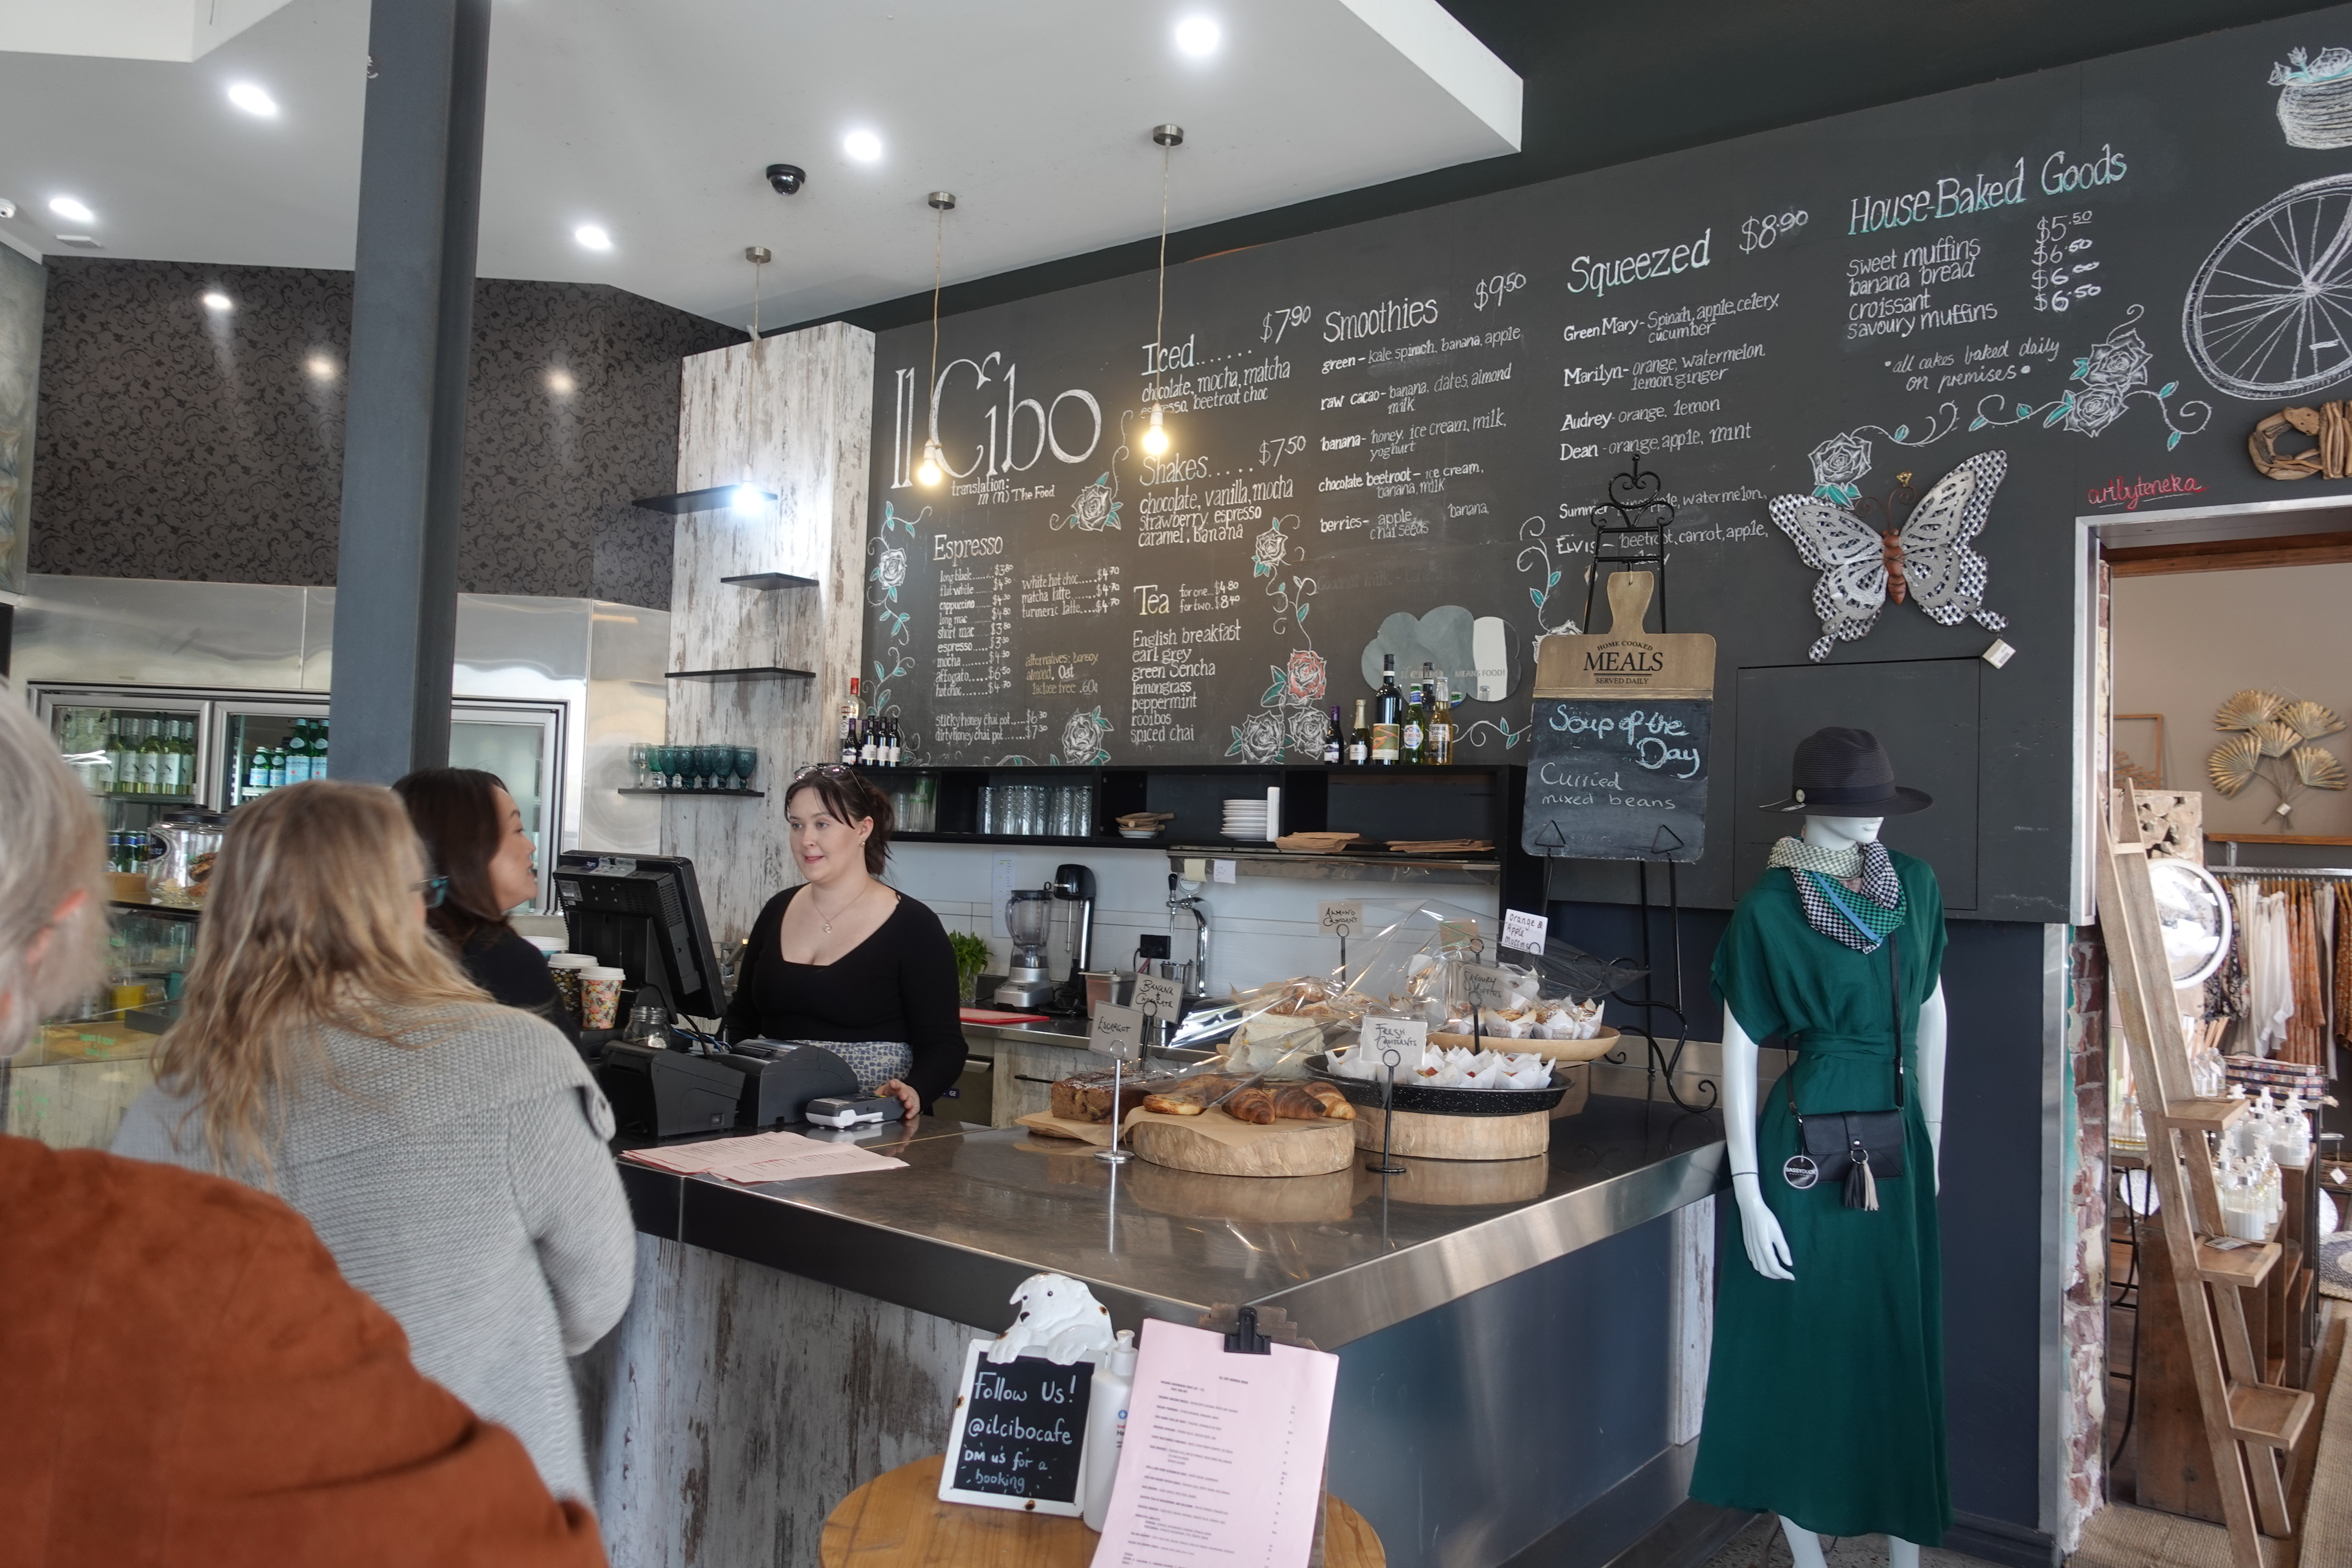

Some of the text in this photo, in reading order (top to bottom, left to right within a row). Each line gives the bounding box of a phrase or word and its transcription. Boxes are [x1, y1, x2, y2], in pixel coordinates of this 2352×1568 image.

[1848, 143, 2128, 235] House-Baked Goods
[1567, 228, 1711, 297] Squeezed
[1847, 249, 1897, 278] sweet
[1904, 235, 1981, 268] muffins
[1849, 271, 1911, 297] banana
[1921, 258, 1976, 286] bread
[1849, 289, 1932, 321] croissant
[1323, 297, 1438, 343] Smoothies
[1847, 313, 1915, 340] savoury
[1921, 303, 1998, 331] muffins
[1564, 325, 1600, 342] Green
[1648, 321, 1717, 343] cucumber
[1141, 334, 1194, 376] Iced
[1321, 355, 1356, 374] green
[1893, 337, 2059, 373] all cakes baked daily
[1244, 355, 1290, 386] matcha
[1631, 368, 1729, 391] lemon ginger
[1906, 364, 2017, 393] on premises
[1320, 362, 1512, 410] raw almond
[1194, 387, 1269, 410] beetroot choc
[1387, 397, 1416, 414] milk
[1673, 398, 1721, 416] lemon
[891, 351, 1101, 488] Il Cibo
[1409, 425, 1427, 440] ice
[1559, 422, 1752, 461] Dean mint
[1370, 441, 1416, 462] yoghurt
[1139, 453, 1208, 487] Shakes
[1318, 467, 1439, 493] chocolate beetroot ice
[951, 477, 1010, 496] translation:
[1011, 488, 1032, 501] The
[1035, 485, 1055, 499] Food
[1252, 475, 1293, 501] mocha
[1419, 478, 1445, 493] milk
[1214, 505, 1262, 529] espresso
[1194, 524, 1243, 542] banana
[1398, 520, 1429, 537] seeds
[934, 534, 1003, 567] Espresso
[940, 567, 972, 585] long black
[1022, 572, 1078, 590] white hot choc
[940, 583, 974, 596] flat white
[1022, 589, 1048, 604] matcha
[1052, 586, 1071, 601] latte
[1133, 585, 1170, 615] Tea
[1179, 583, 1192, 598] for
[939, 599, 975, 615] cappuccino
[1022, 599, 1081, 619] turmeric latte
[1179, 598, 1193, 613] for
[939, 612, 968, 628] long mac
[937, 626, 974, 639] short mac
[1133, 619, 1241, 648] English breakfast
[937, 643, 973, 656] espresso
[1132, 647, 1192, 664] earl grey
[1597, 641, 1653, 651] HOME COOKED
[937, 653, 961, 668] mocha
[1132, 658, 1216, 682] green Sencha
[1583, 652, 1663, 671] MEALS
[936, 668, 969, 687] affogato
[936, 683, 962, 697] hot choc
[1132, 681, 1191, 696] lemongrass
[1132, 691, 1197, 713] peppermint
[935, 711, 1010, 729] sticky honey chai pot
[1131, 710, 1172, 726] rooibos
[1549, 704, 1690, 746] Soup of the
[935, 727, 1003, 745] dirty honey chai pot
[1130, 725, 1194, 743] spiced chai
[1635, 737, 1700, 779] Day
[1540, 762, 1623, 790] Curried
[1542, 793, 1675, 809] mixed beans
[975, 1372, 1076, 1403] Follow Us!
[968, 1414, 1072, 1445] @ilcibocafe
[965, 1449, 1048, 1471] DM us for a
[976, 1468, 1025, 1494] booking
